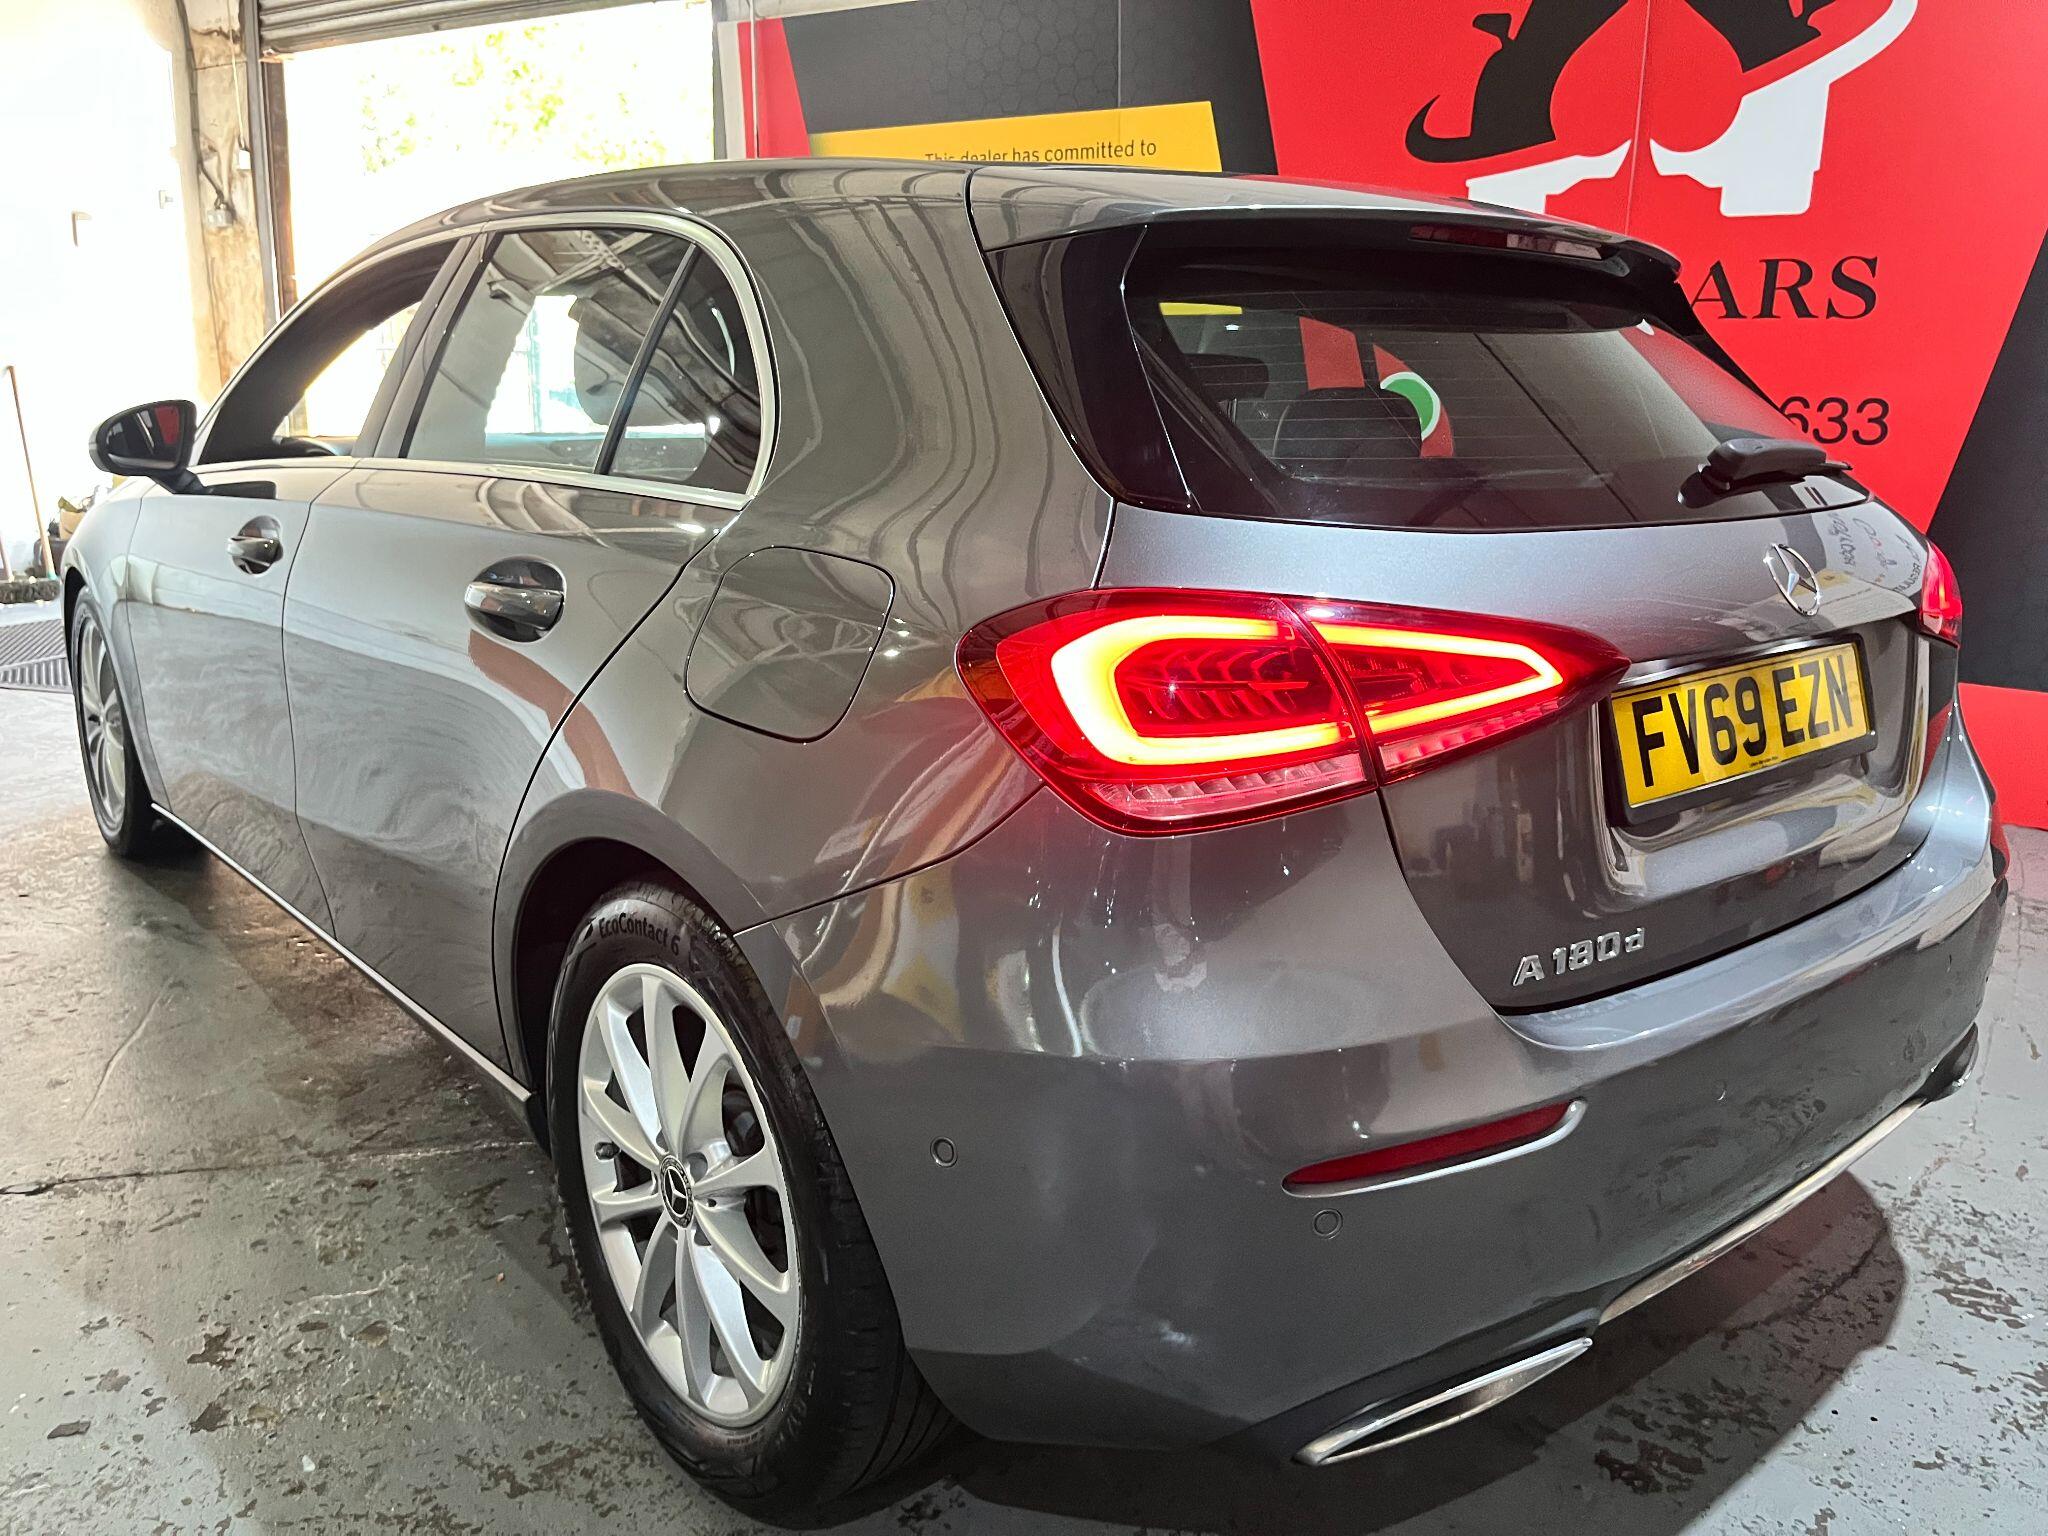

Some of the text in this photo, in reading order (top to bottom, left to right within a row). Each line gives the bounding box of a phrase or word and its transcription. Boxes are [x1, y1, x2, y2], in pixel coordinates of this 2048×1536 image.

[1012, 147, 1040, 162] has
[1044, 139, 1135, 162] committed
[1140, 139, 1157, 157] to
[1631, 653, 1854, 788] FV69 EZN
[600, 912, 681, 956] EcoContact 6
[1512, 954, 1546, 987] A
